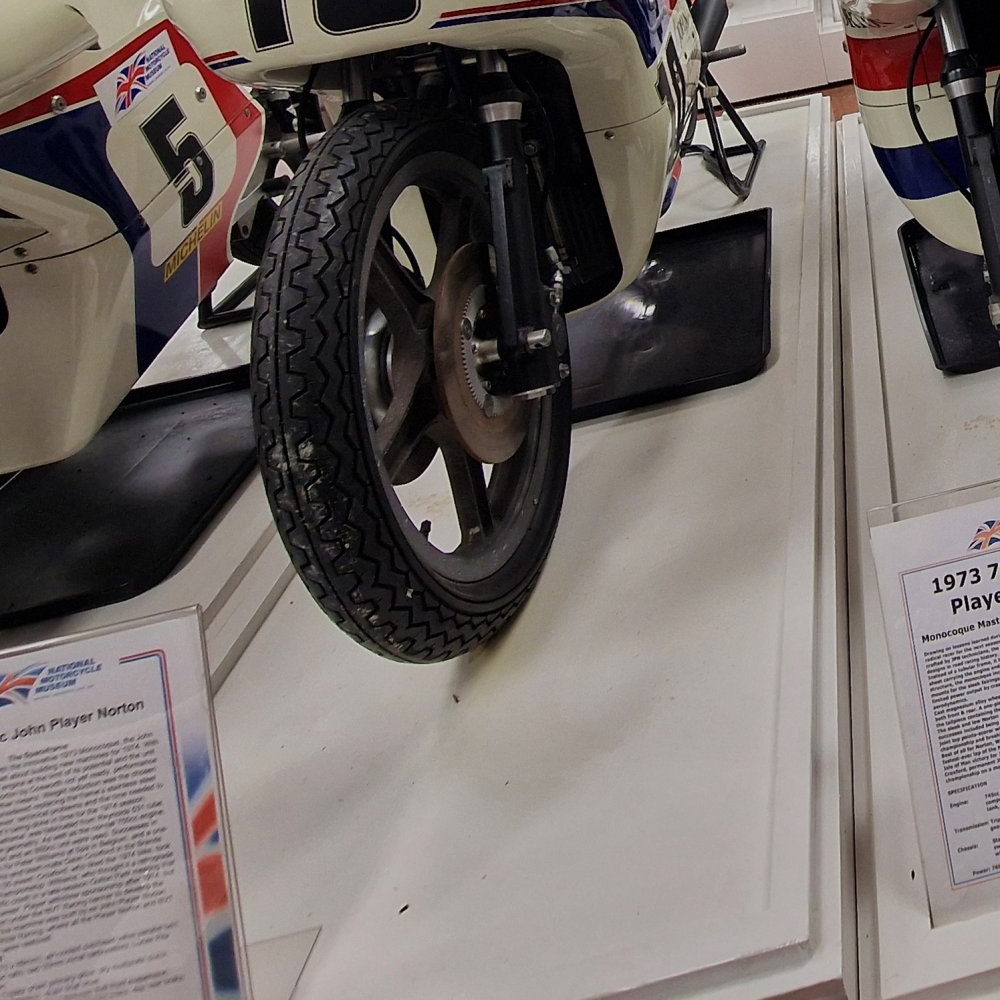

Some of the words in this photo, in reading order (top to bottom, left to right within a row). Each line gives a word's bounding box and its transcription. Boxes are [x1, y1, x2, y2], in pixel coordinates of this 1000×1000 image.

[139, 93, 215, 229] 5
[165, 203, 222, 276] MICHELIN
[931, 567, 981, 593] 1973
[921, 622, 975, 644] Monocoque
[41, 664, 102, 685] MOTORCYCLE
[47, 657, 96, 675] NATIONAL
[35, 678, 77, 694] MUSEUM
[12, 720, 47, 740] John
[50, 710, 94, 732] Player
[97, 699, 145, 721] Norton
